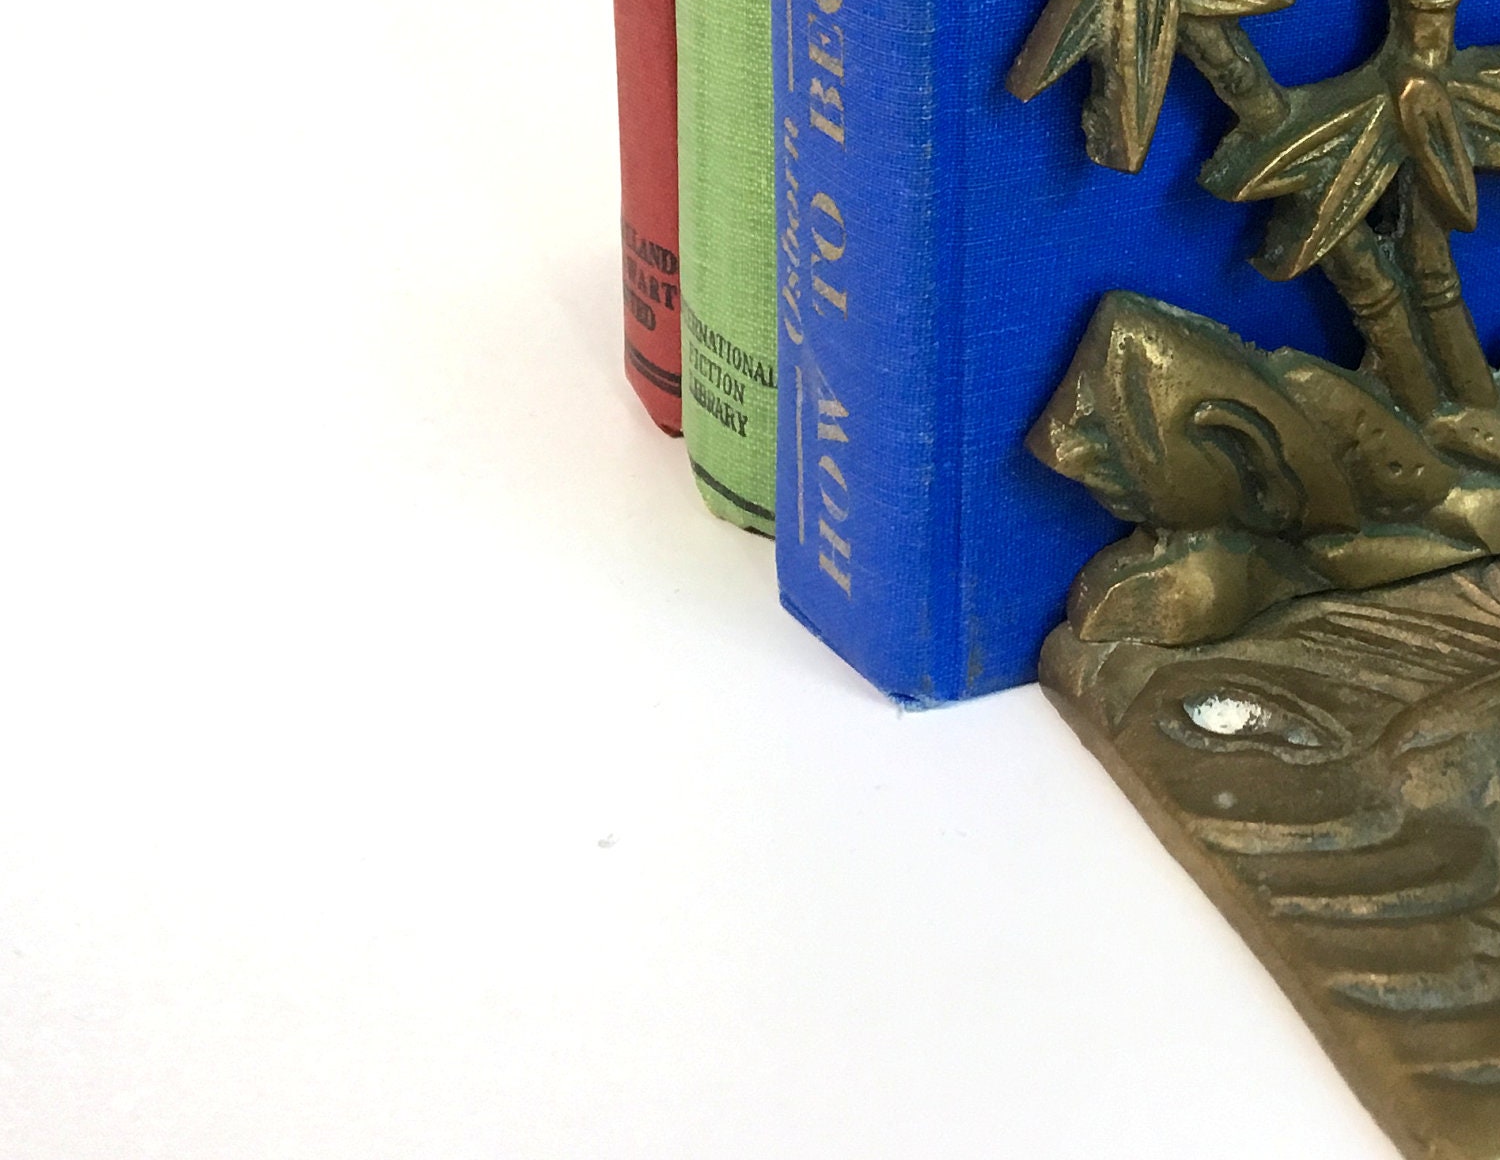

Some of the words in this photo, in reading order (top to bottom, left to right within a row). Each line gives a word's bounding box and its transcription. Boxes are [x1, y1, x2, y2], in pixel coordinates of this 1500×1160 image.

[811, 192, 849, 320] TO
[689, 342, 746, 405] FICTION
[689, 369, 749, 437] LIBRARY
[816, 385, 852, 601] HOW
